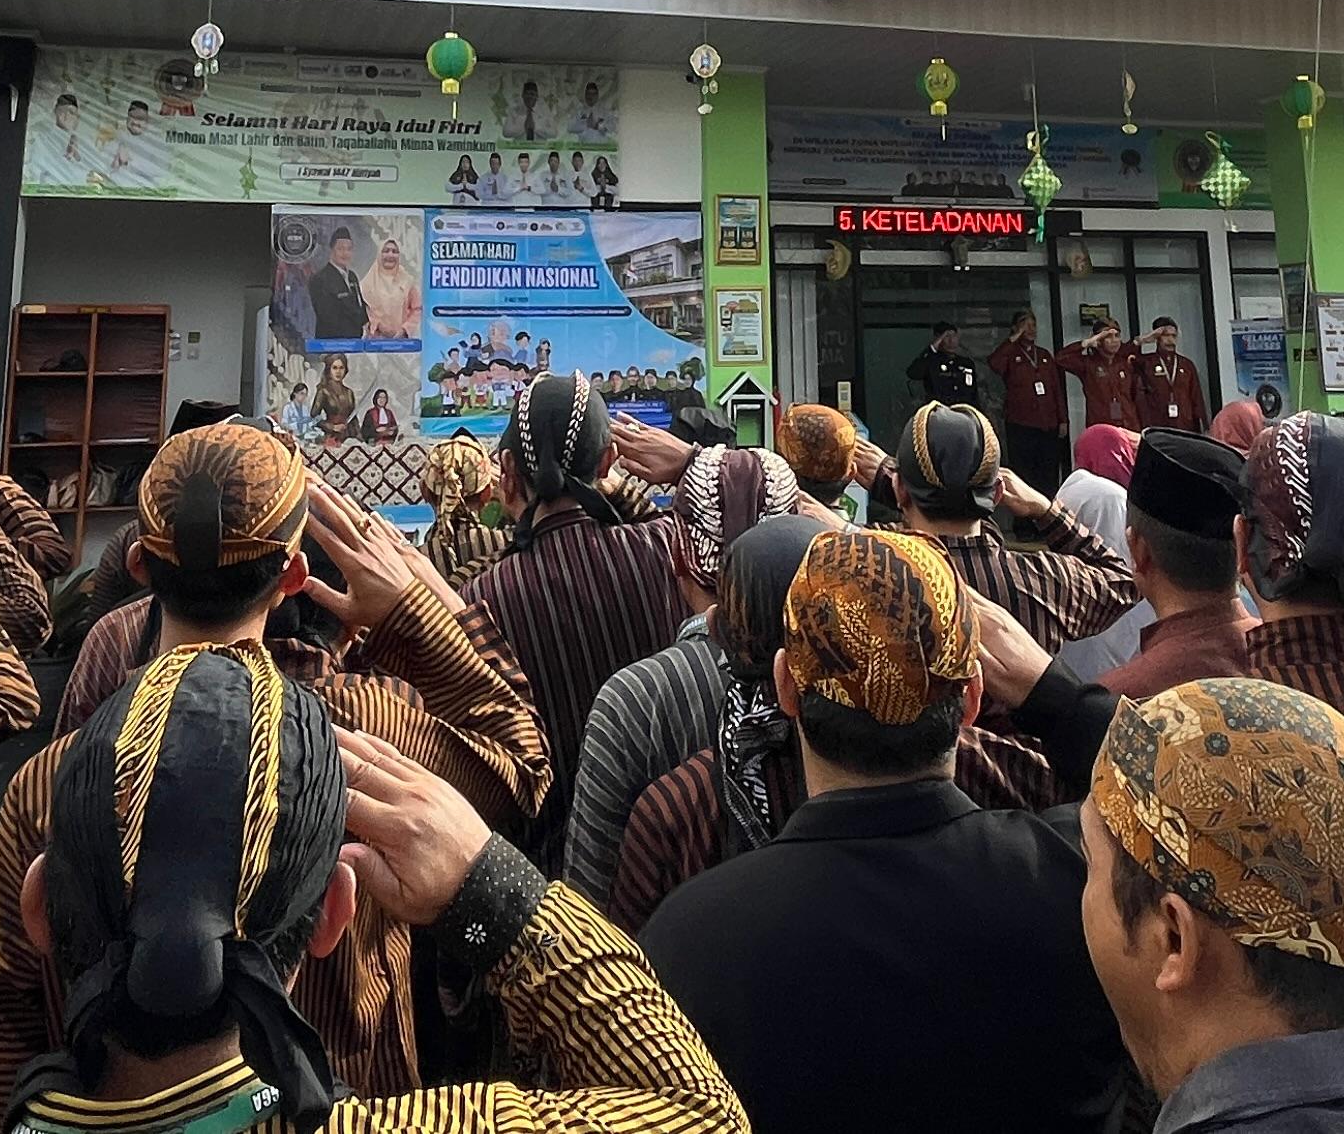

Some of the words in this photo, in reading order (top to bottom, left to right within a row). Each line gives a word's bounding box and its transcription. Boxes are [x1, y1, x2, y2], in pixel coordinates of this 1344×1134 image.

[201, 113, 288, 129] Selamat
[291, 116, 339, 130] Hari
[342, 118, 391, 134] Raya
[395, 119, 436, 134] Idul
[438, 119, 482, 135] Fitri
[165, 130, 206, 145] Mohon
[241, 132, 270, 146] Lahir
[273, 132, 294, 147] dan
[839, 209, 856, 232] 5.
[862, 208, 1023, 234] KETELADANAN
[431, 242, 484, 260] SELAMAT
[487, 243, 515, 261] HARI
[431, 267, 522, 288] PENDIDIKAN
[525, 267, 598, 288] NASIONAL
